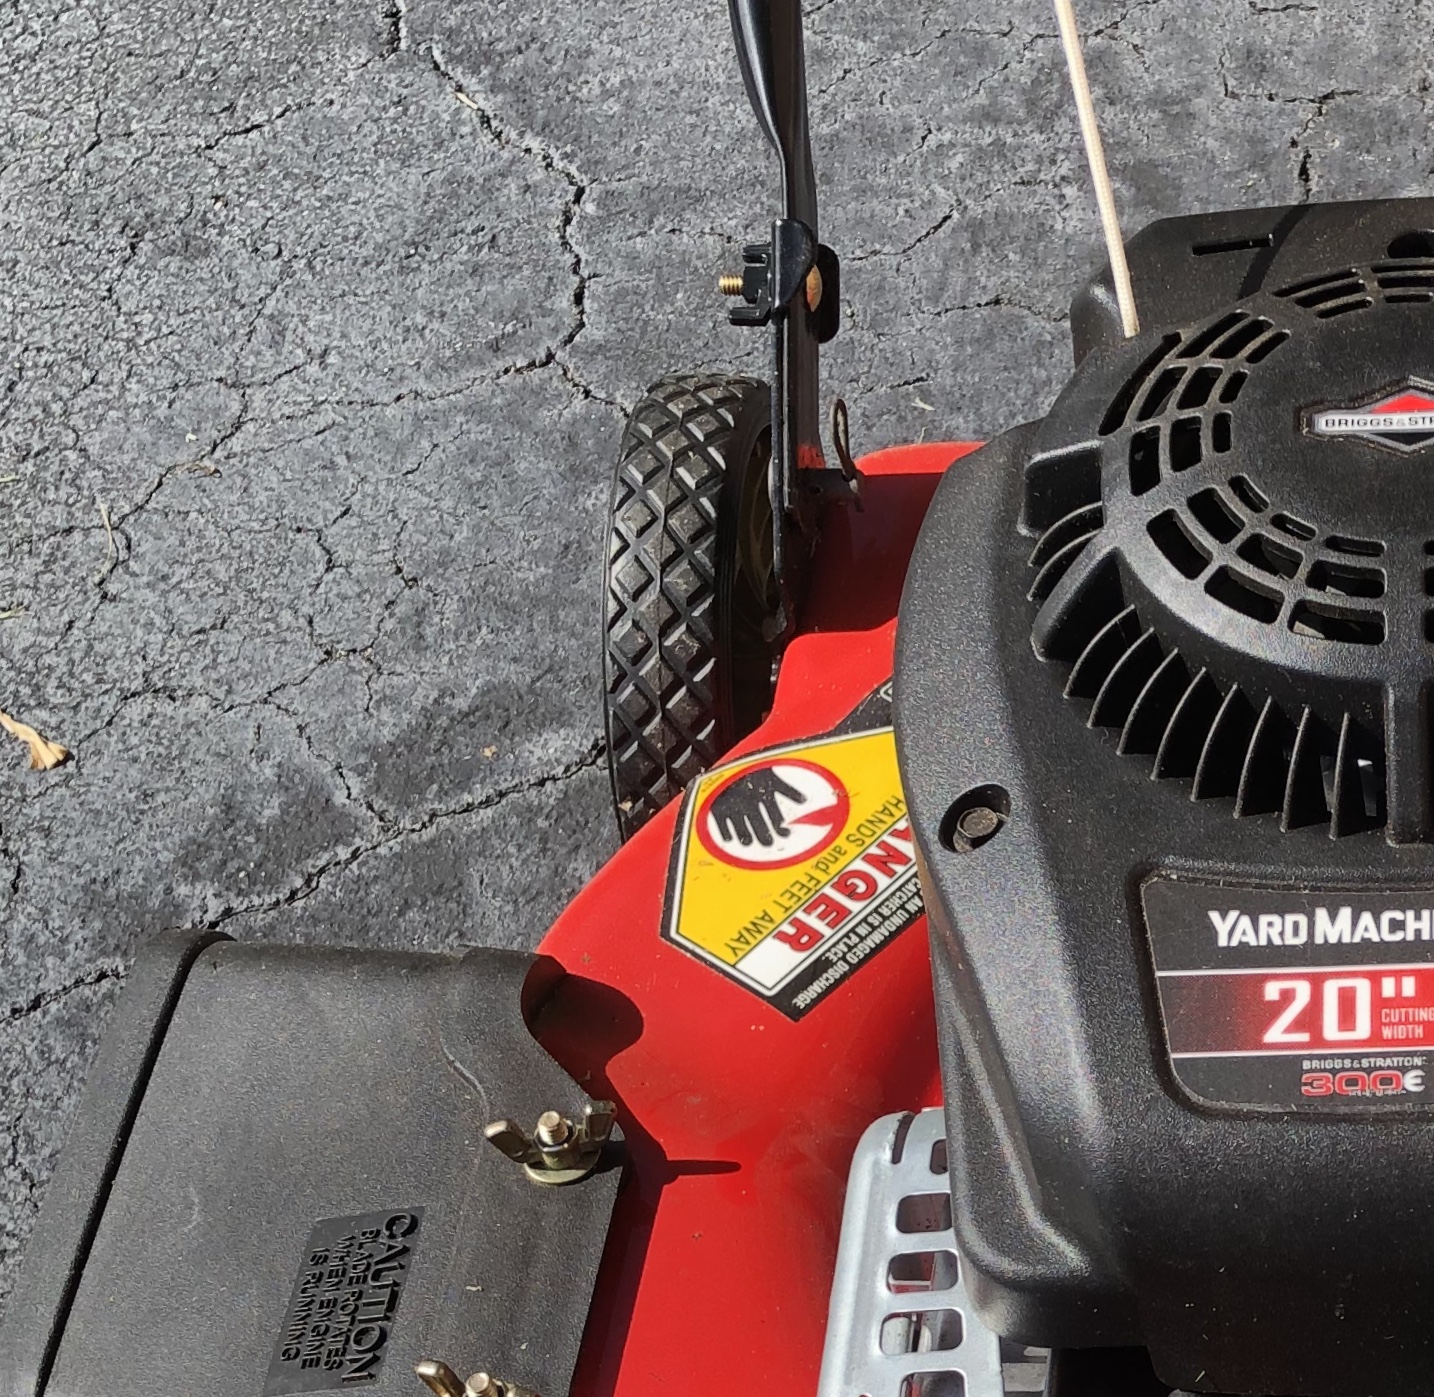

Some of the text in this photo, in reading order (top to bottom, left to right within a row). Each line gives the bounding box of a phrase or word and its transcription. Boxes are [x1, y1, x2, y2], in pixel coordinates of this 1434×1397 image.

[724, 793, 906, 959] HANDS and FEET AWAY
[846, 911, 910, 964] UNDAMAGED
[855, 922, 872, 937] IN
[867, 913, 883, 926] IS
[1207, 909, 1308, 947] YARD
[822, 932, 859, 963] PLACE.
[792, 960, 849, 1010] DISCHARGE
[1381, 1024, 1424, 1039] WIDTH
[280, 1247, 330, 1362] IS RUNNING
[301, 1235, 356, 1370] WHEN ENGINE
[323, 1228, 381, 1371] BLADE ROTATES
[341, 1212, 419, 1383] CAUTION
